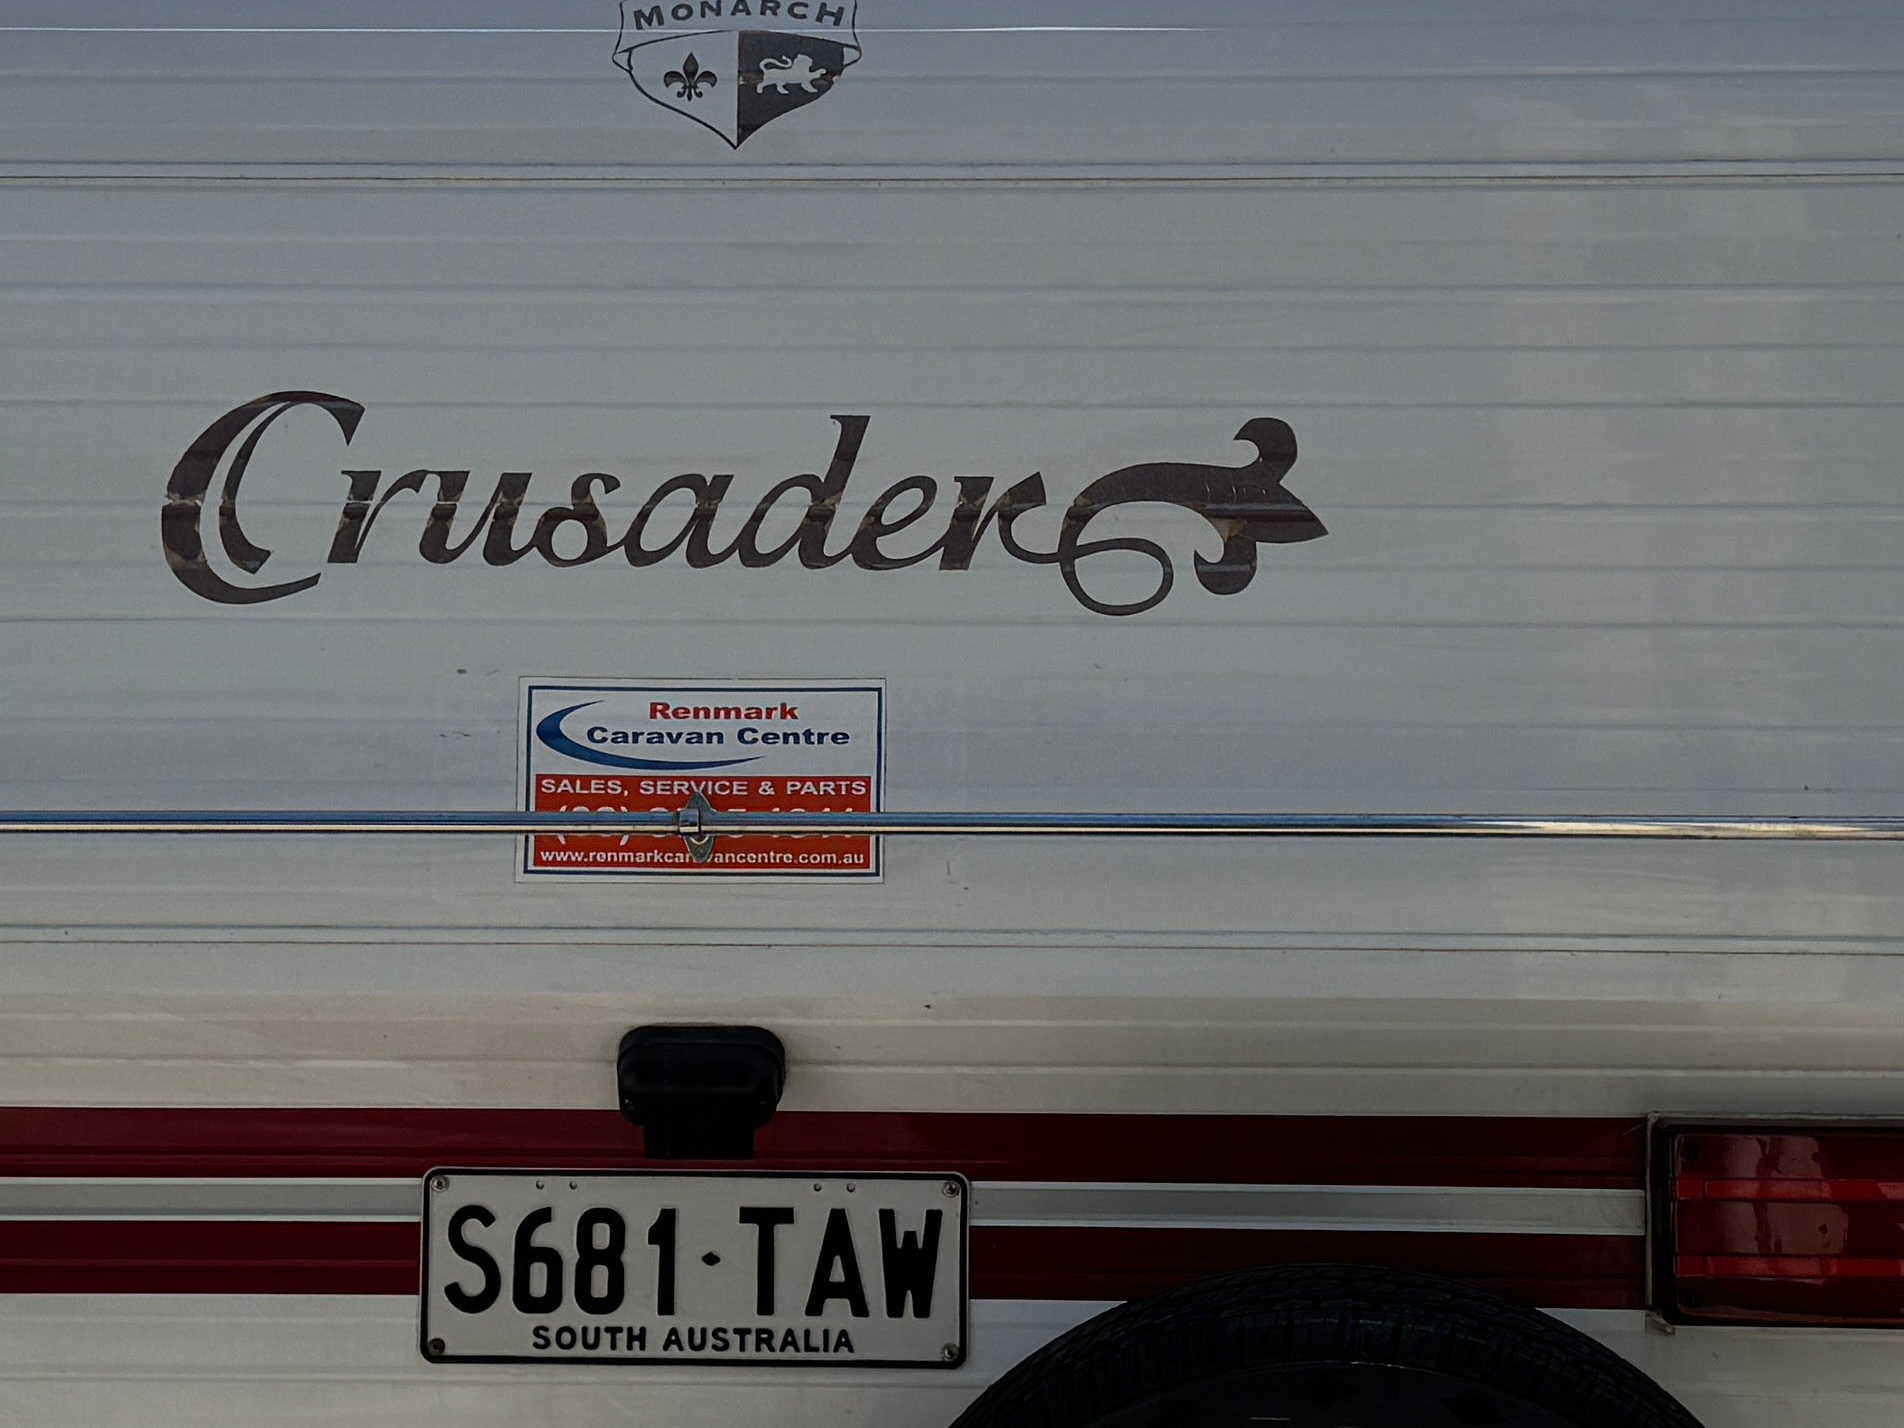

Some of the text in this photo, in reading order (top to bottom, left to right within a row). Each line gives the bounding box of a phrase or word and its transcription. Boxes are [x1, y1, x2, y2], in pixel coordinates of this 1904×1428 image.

[161, 389, 1071, 608] Crusader
[649, 701, 799, 721] Renmark
[586, 726, 851, 746] Caravan Centre
[541, 778, 867, 797] SALES, SERVICE & PARTS
[532, 1325, 855, 1354] SOUTH AUSTRALIA
